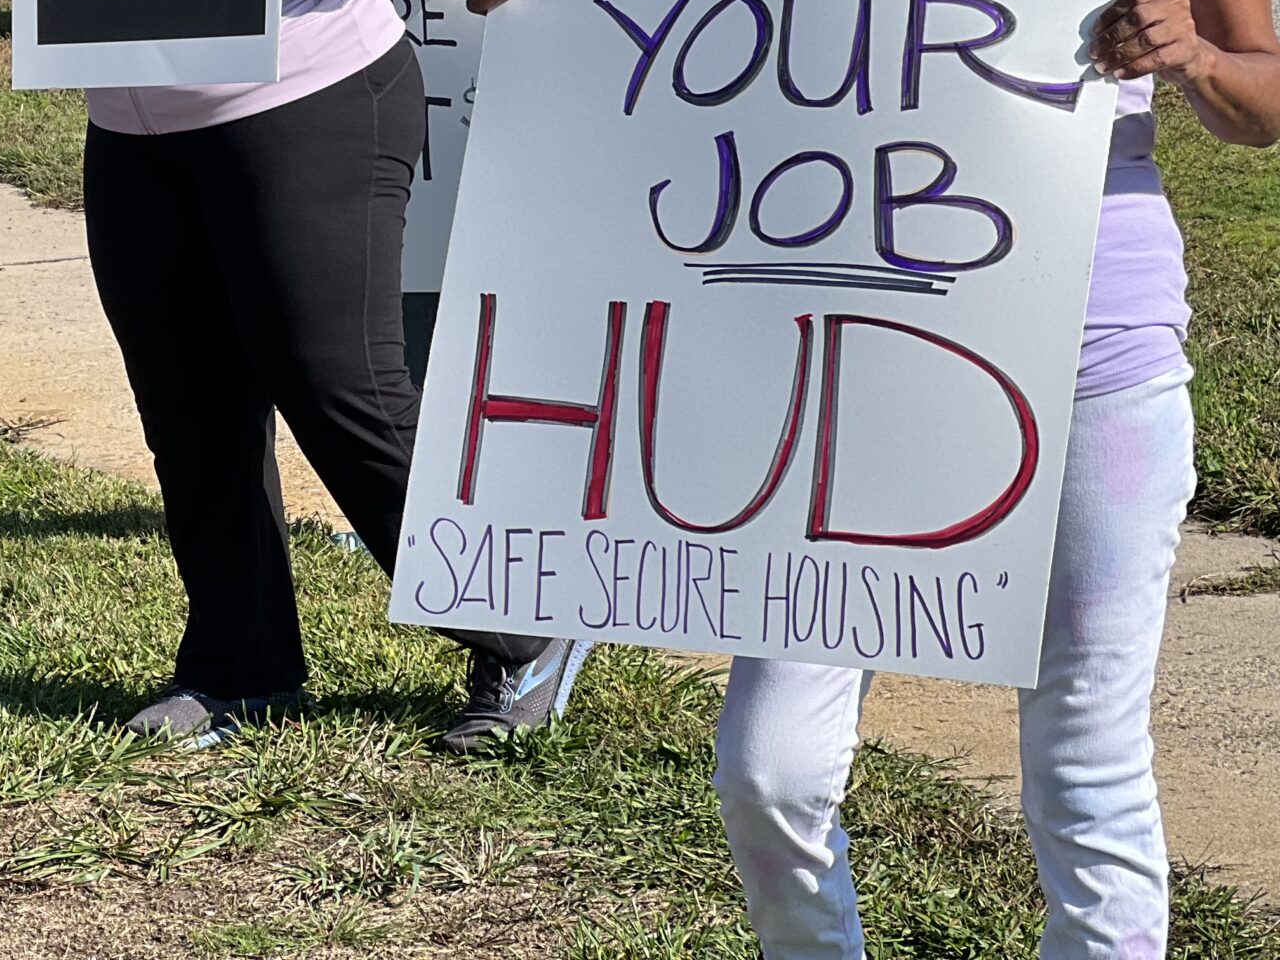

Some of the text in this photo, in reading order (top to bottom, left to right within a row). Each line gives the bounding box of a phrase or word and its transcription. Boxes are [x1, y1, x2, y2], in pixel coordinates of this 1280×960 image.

[649, 130, 1014, 274] JOB
[457, 292, 1040, 550] HUD
[578, 529, 743, 641] SECURE
